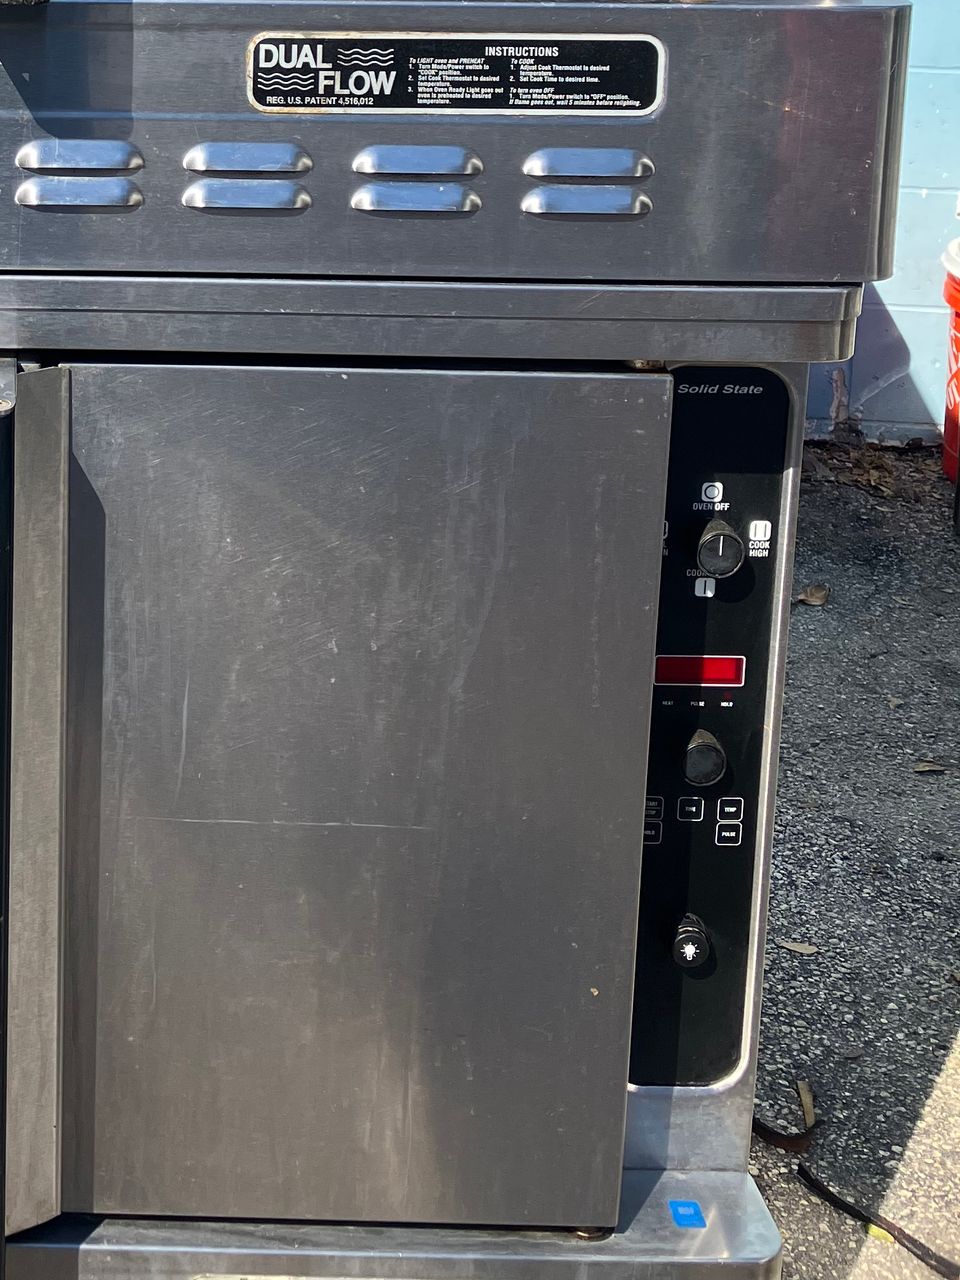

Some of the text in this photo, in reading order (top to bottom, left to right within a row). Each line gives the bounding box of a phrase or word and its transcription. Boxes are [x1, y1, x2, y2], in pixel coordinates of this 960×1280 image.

[259, 44, 332, 68] DUAL
[485, 46, 559, 57] INSTRUCTIONS
[318, 71, 396, 95] FLOW
[266, 96, 374, 106] REG. U.S. PATENT 4,516,012
[677, 384, 763, 394] Solid State
[693, 503, 730, 511] OVEN OFF
[749, 541, 770, 549] COOK
[749, 549, 769, 558] HIGH
